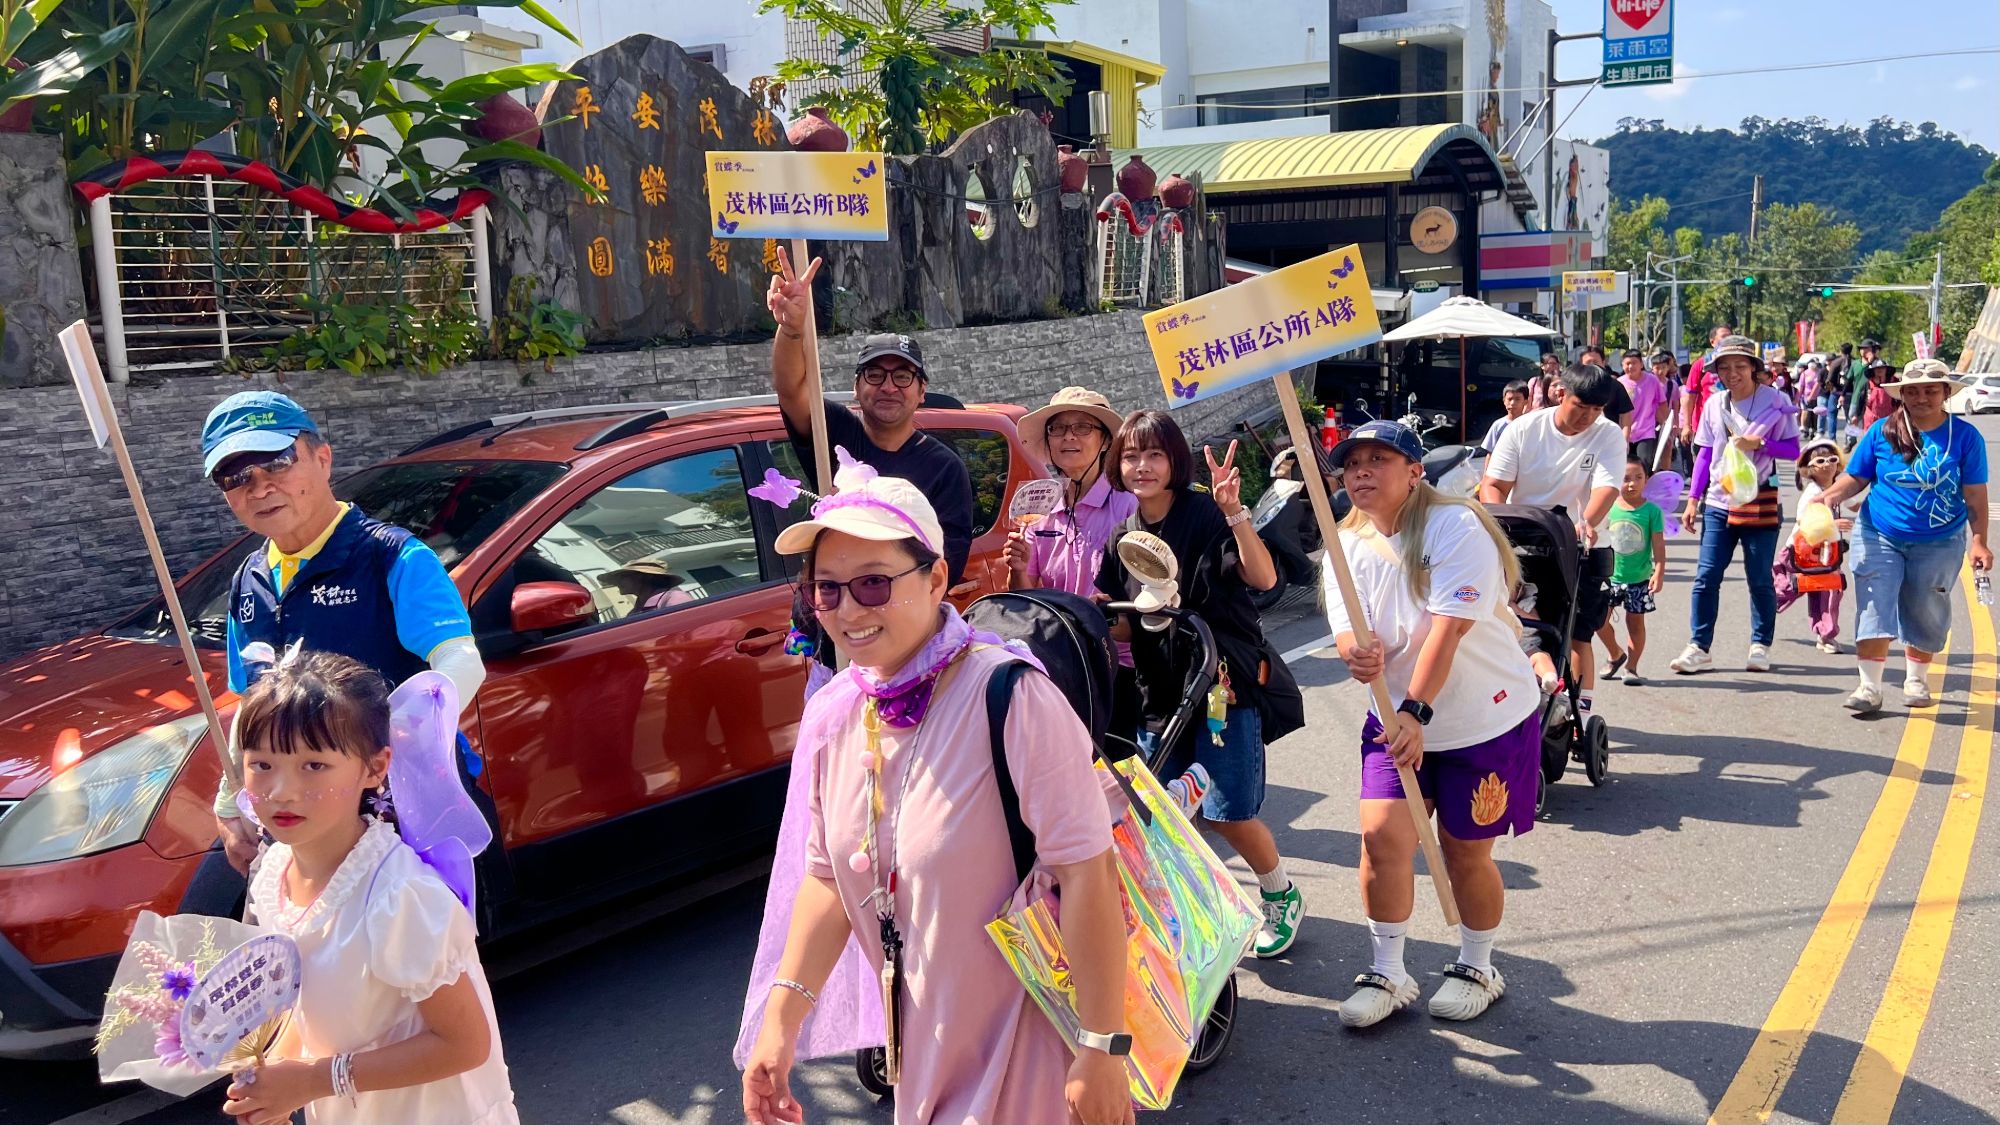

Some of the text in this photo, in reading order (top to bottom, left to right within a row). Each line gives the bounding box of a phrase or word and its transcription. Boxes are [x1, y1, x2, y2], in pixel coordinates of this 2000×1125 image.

[1606, 64, 1669, 82] 生鮮門市
[571, 86, 777, 146] 平安茂林
[724, 191, 870, 217] 茂林區公所B隊
[1174, 295, 1358, 378] 茂林區公所A隊
[310, 584, 341, 606] 茂林
